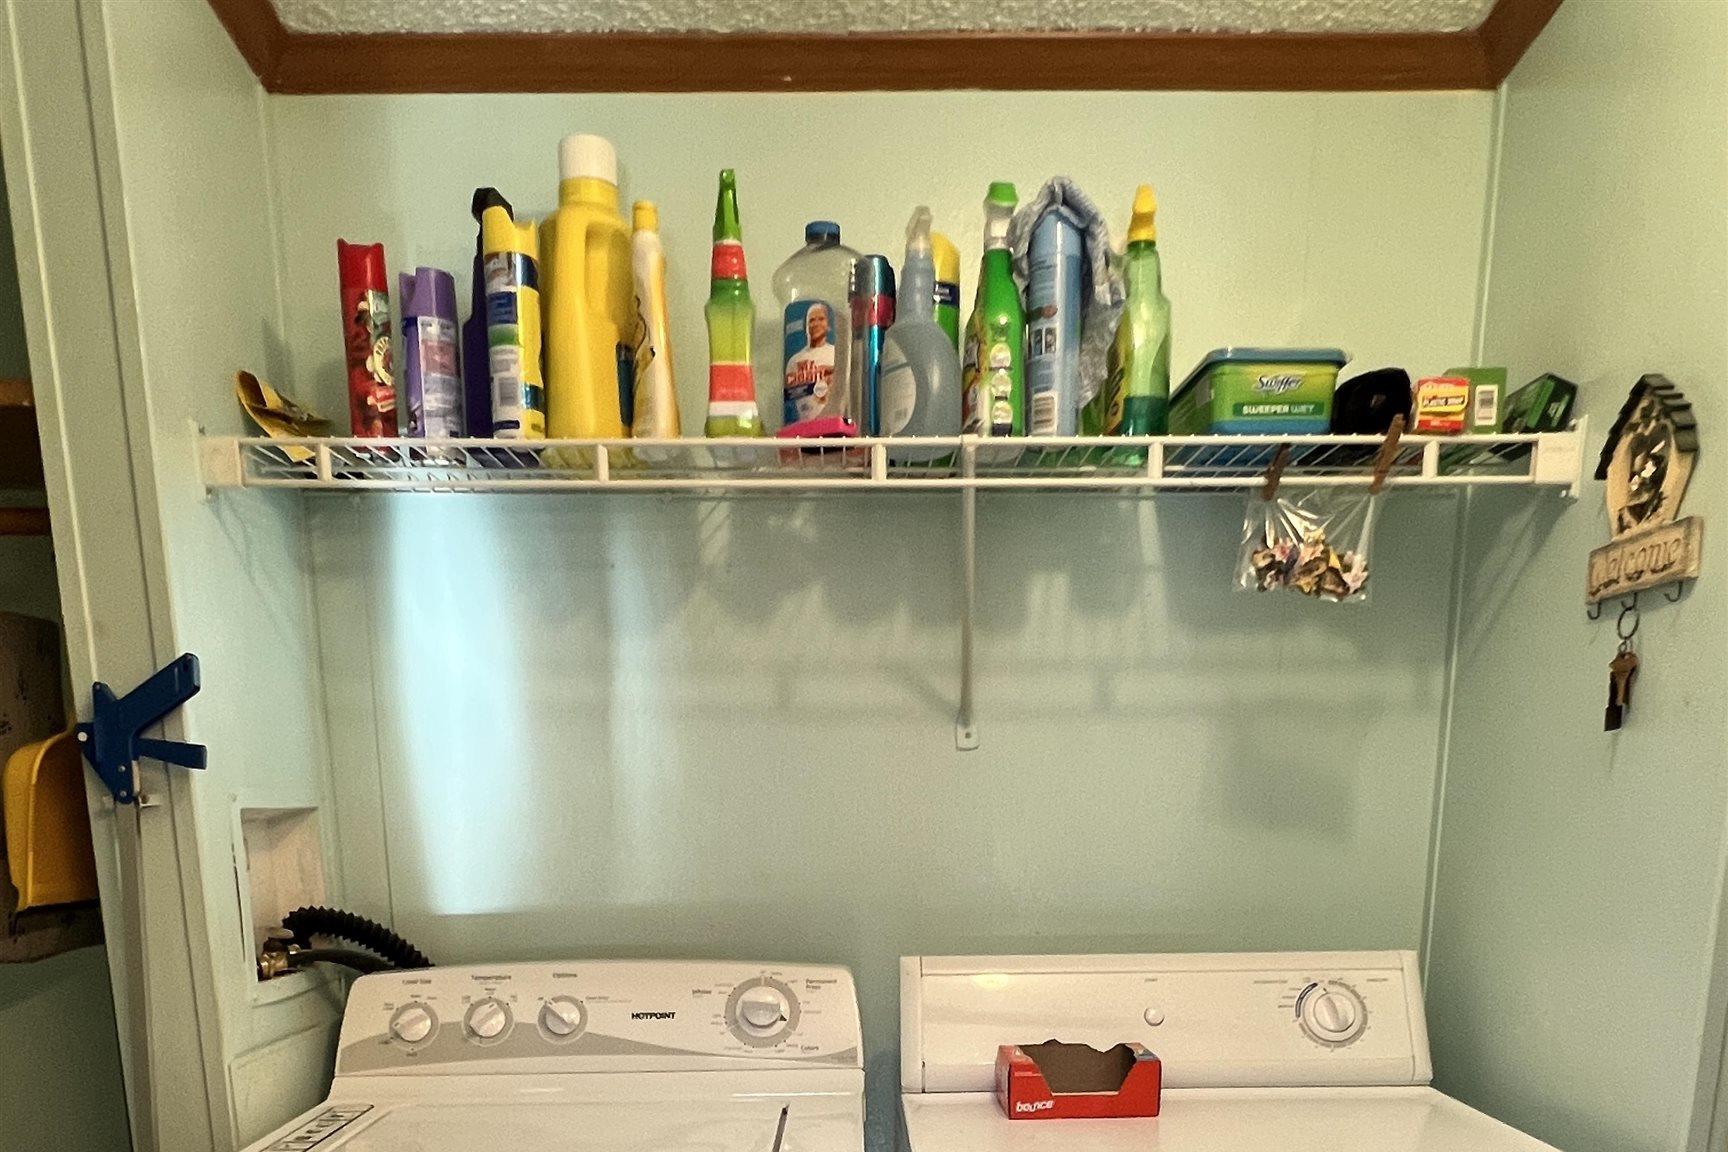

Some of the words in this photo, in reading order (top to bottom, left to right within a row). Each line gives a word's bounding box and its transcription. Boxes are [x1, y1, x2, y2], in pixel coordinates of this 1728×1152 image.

[1257, 375, 1302, 392] Swiffer
[1242, 404, 1290, 415] SWEEPER
[631, 1012, 676, 1020] HOTPOINT
[1016, 1100, 1054, 1112] bounce
